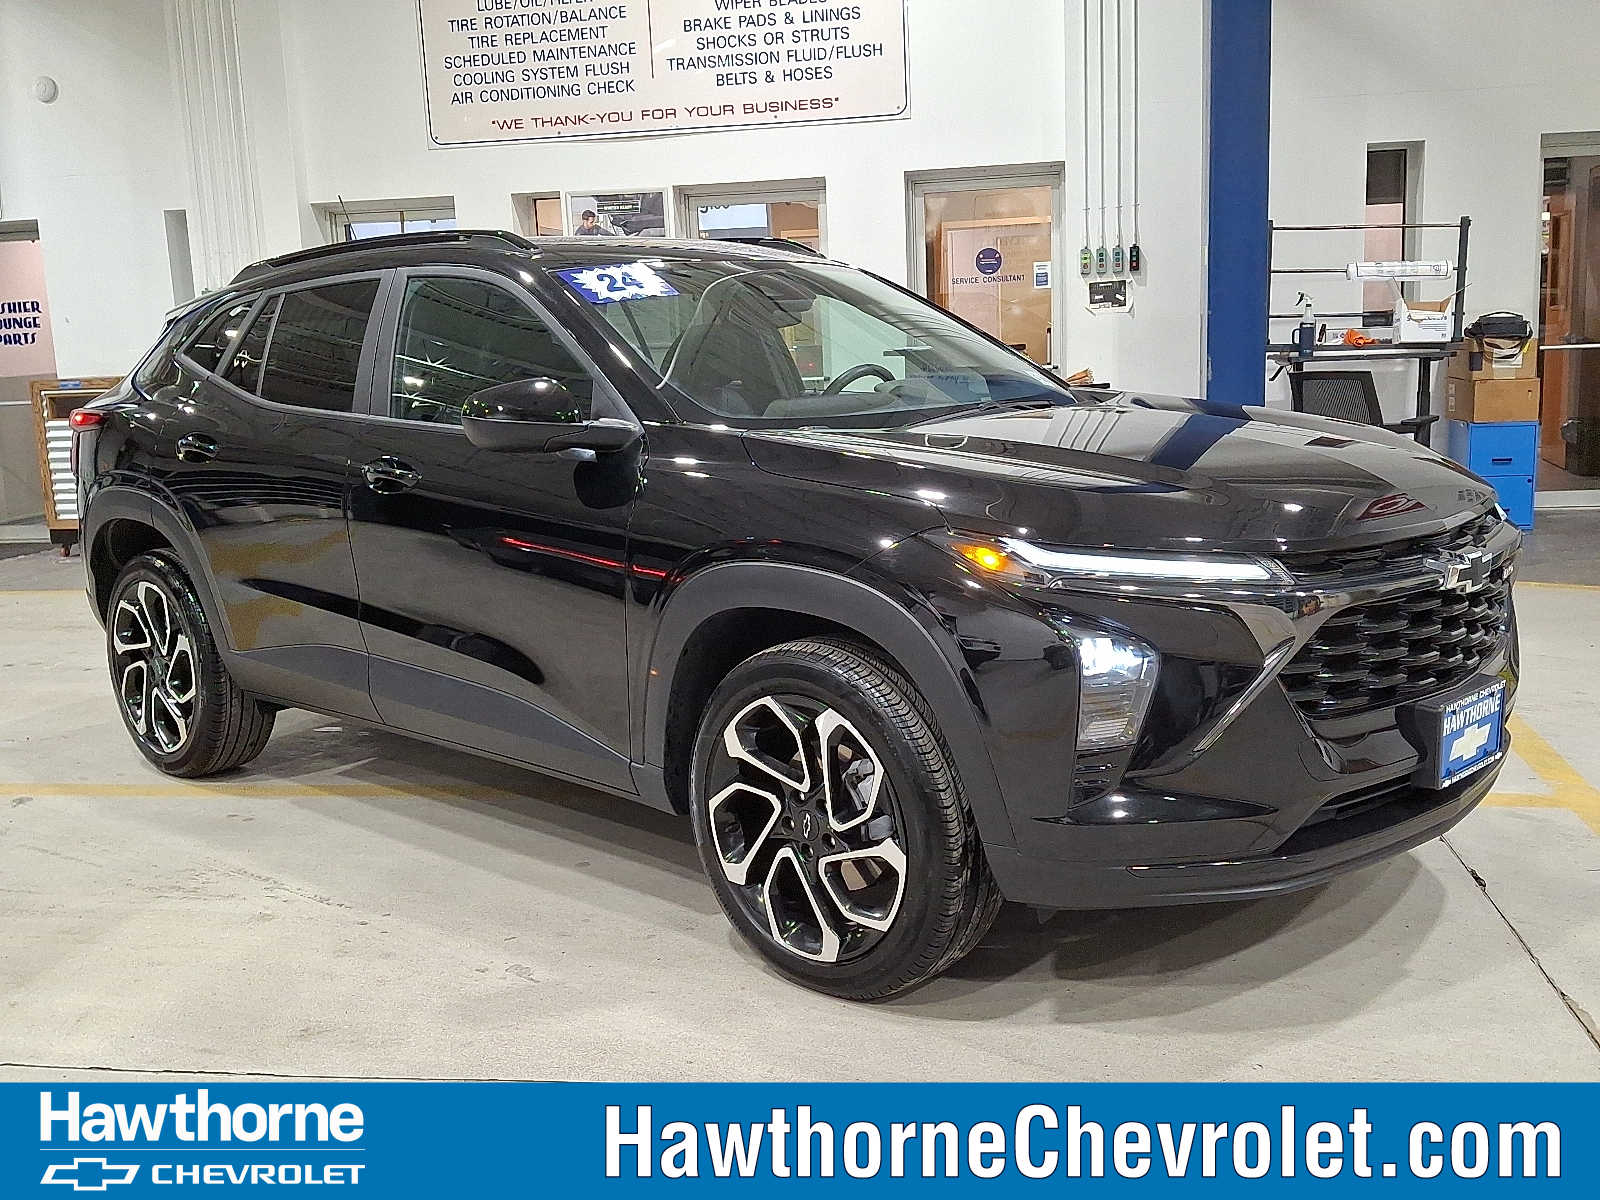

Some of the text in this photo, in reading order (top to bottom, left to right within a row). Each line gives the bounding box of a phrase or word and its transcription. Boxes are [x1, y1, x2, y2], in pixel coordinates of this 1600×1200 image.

[448, 6, 627, 32] TIRE ROTATION/BALANCE
[683, 6, 861, 32] BRAKE PADS & LININGS
[468, 26, 608, 49] TIRE REPLACEMENT
[696, 26, 850, 50] SHOCKS OR STRUTS
[444, 42, 637, 69] SCHEDULED MAINTENANCE
[667, 43, 883, 71] TRANSMISSION FLUID/FLUSH
[453, 61, 630, 86] COOLING SYSTEM FLUSH
[716, 66, 833, 87] BELTS & HOSES
[451, 79, 636, 105] AIR CONDITIONING CHECK
[531, 111, 633, 128] THANK-YOU
[641, 108, 677, 121] FOR
[685, 104, 735, 118] YOUR
[743, 97, 840, 115] BUSINESS"
[952, 274, 1025, 285] SERVICE CONSULTANT
[1443, 693, 1502, 737] HAWTHORNE
